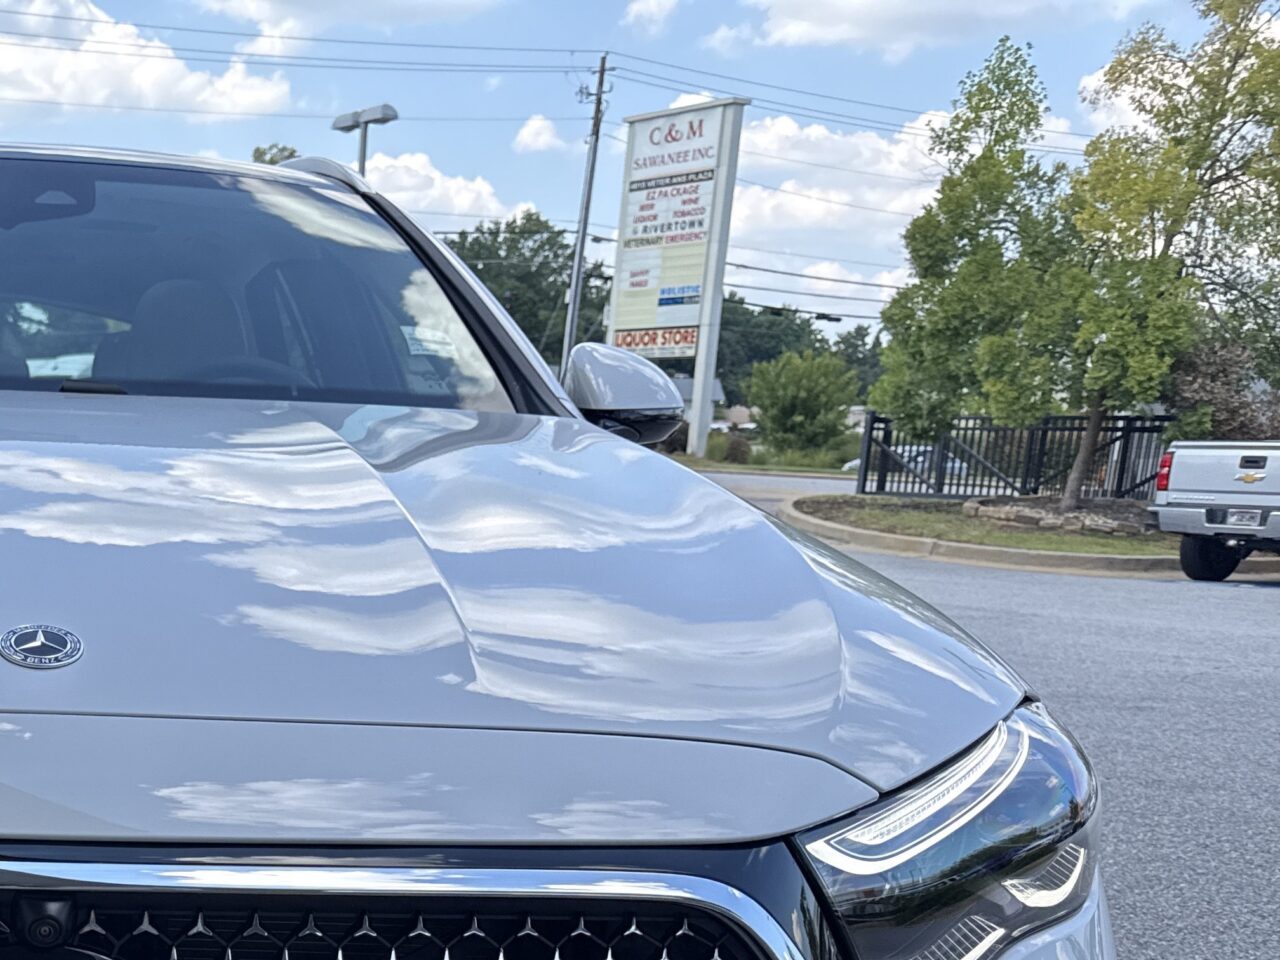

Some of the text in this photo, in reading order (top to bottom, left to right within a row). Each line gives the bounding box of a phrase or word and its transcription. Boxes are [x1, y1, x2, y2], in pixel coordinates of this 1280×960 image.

[649, 119, 704, 145] C & M
[641, 218, 705, 234] RIVERTOWN
[616, 329, 696, 347] LIQUOR STORE
